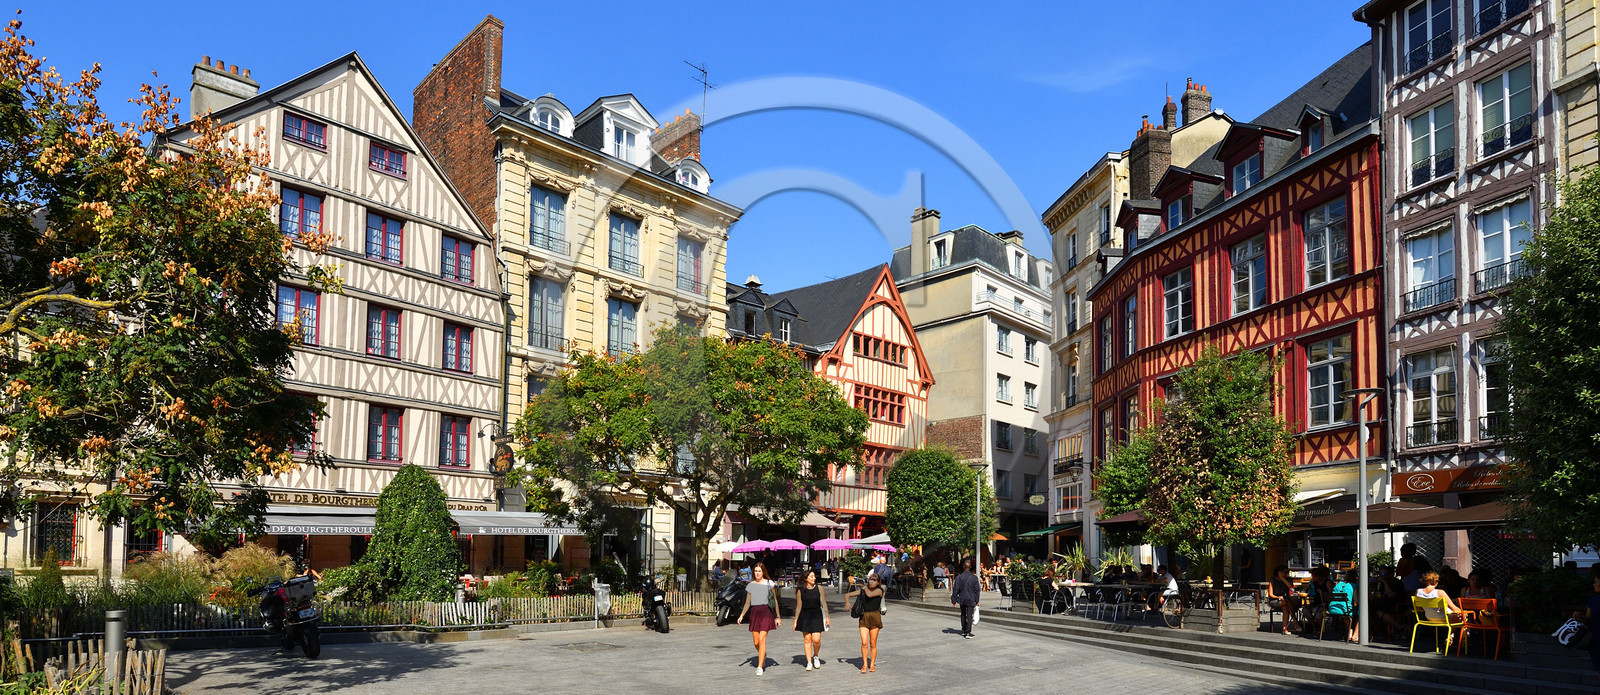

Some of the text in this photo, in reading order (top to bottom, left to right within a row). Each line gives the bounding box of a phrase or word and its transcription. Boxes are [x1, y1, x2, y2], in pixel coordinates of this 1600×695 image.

[270, 492, 379, 507] TEL DE BOURGTHERO
[272, 525, 286, 533] DE
